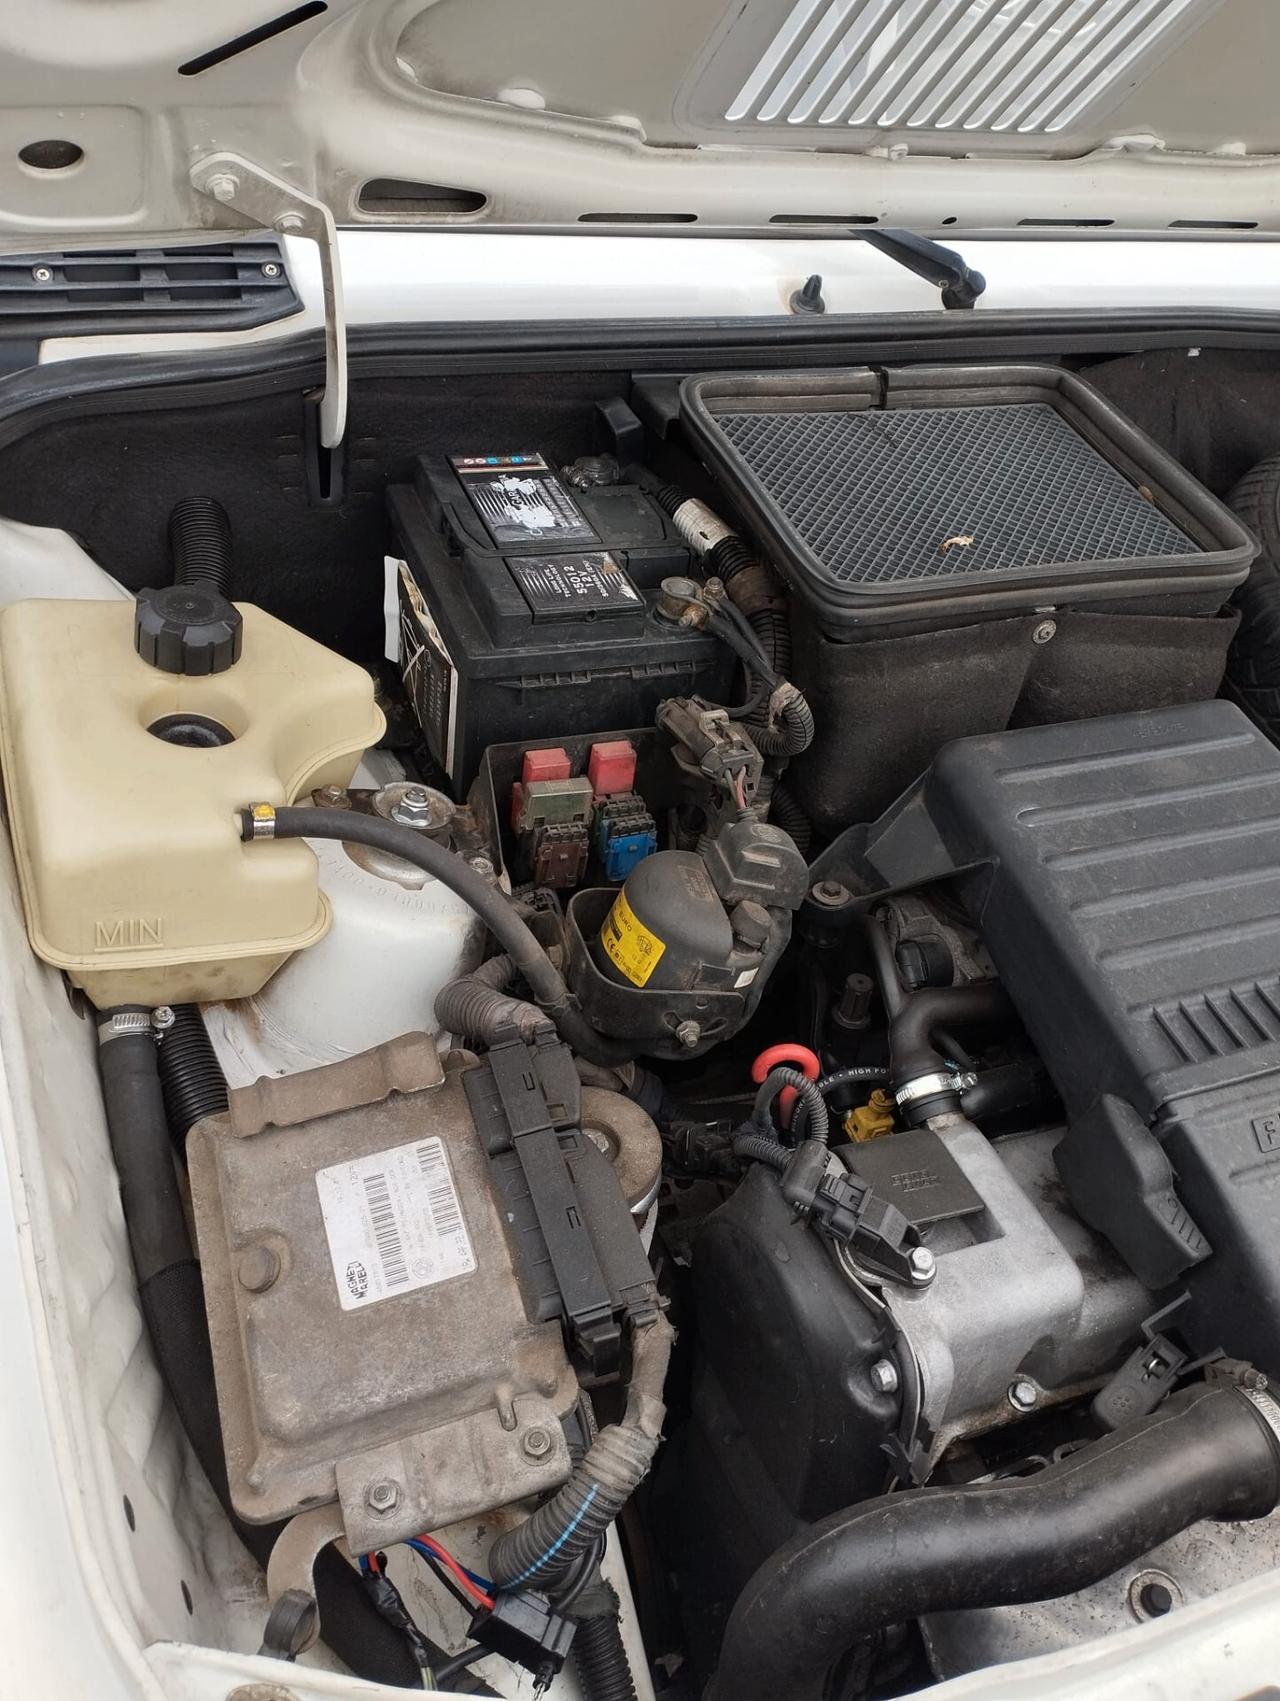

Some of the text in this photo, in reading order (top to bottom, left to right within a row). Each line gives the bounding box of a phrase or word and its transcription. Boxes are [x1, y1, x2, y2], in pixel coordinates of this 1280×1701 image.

[563, 565, 587, 594] 55012
[577, 570, 595, 587] 12V
[95, 918, 163, 946] MIN
[848, 1068, 872, 1077] HIGH
